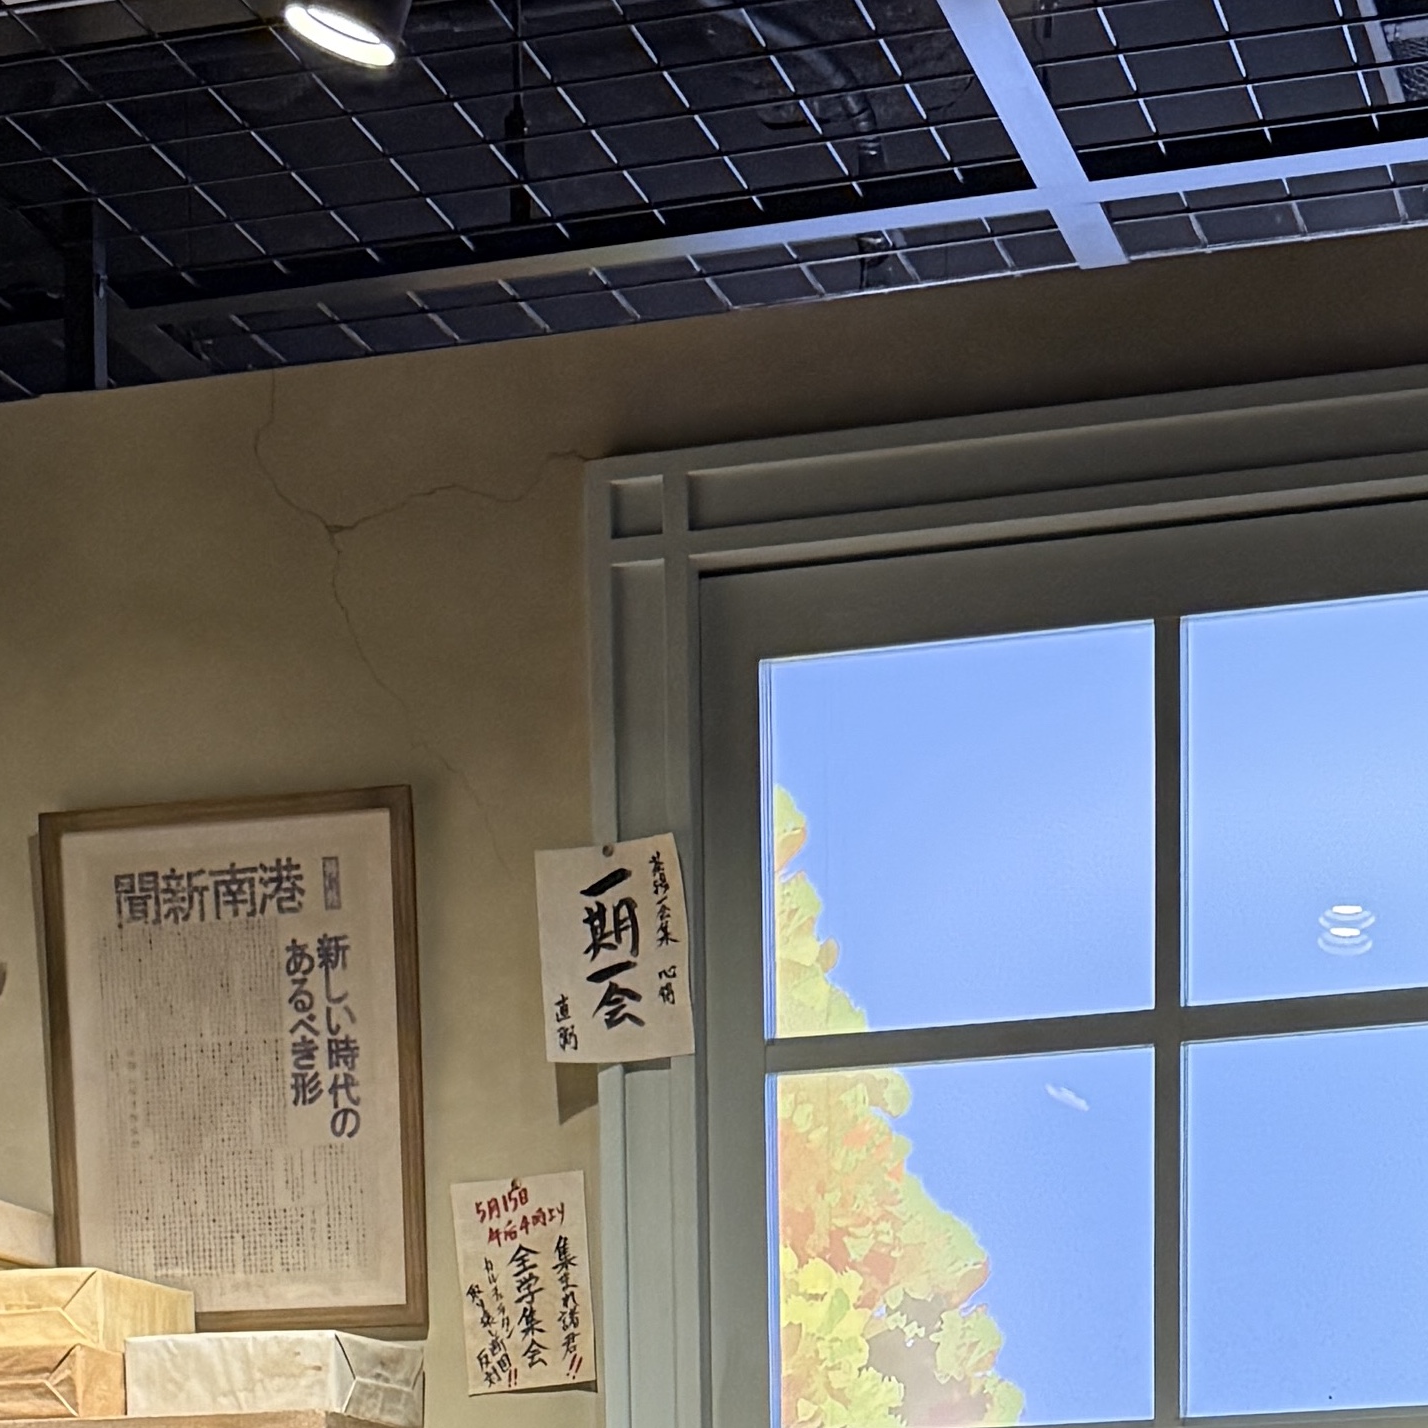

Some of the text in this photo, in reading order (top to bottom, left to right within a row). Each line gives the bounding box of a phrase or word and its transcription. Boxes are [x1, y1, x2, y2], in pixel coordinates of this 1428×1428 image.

[285, 939, 323, 1107] あるべき形
[580, 868, 645, 1029] 一期一会
[317, 933, 361, 1139] 新しい時代の
[475, 1188, 529, 1223] 5月15日
[509, 1244, 550, 1368] 全学集会
